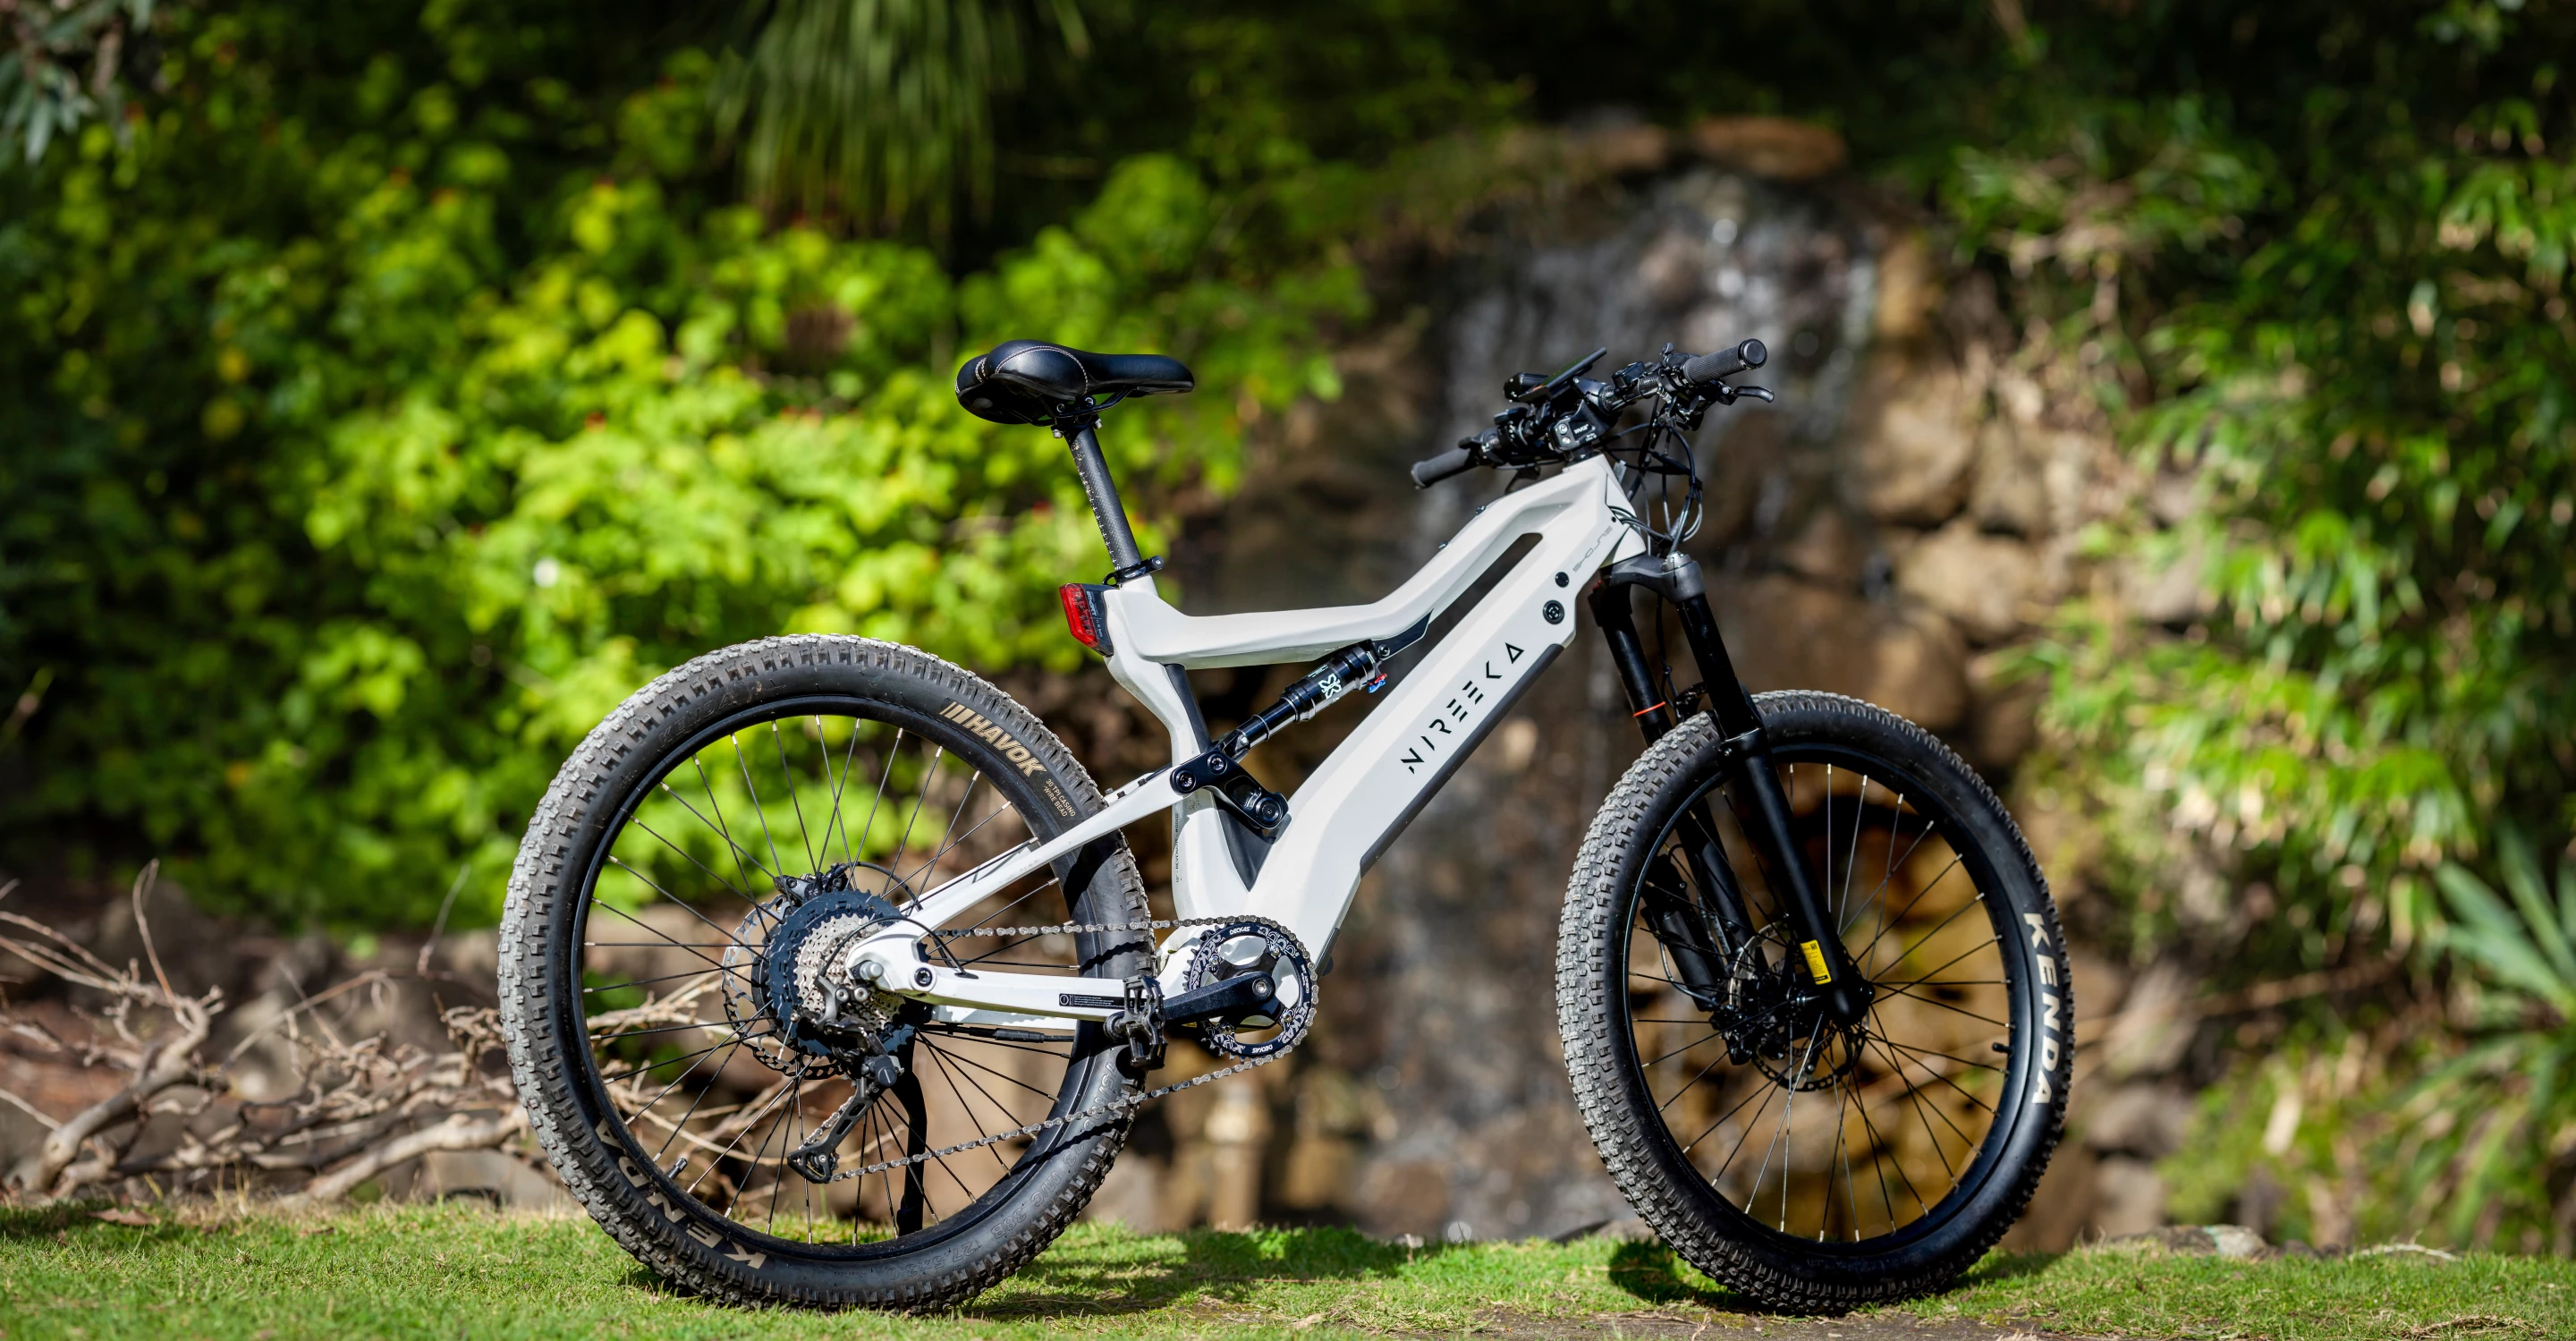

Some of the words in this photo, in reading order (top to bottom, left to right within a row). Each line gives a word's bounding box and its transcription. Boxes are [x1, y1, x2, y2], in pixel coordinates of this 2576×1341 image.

[1400, 642, 1524, 775] NIREEKA
[962, 715, 1047, 777] HAVOK
[1044, 785, 1056, 802] WIRE
[1055, 801, 1067, 816] BEAD
[1046, 778, 1054, 787] 30
[1052, 785, 1062, 796] TPI
[1058, 795, 1075, 816] CASING
[1229, 926, 1250, 936] DECKAS
[2023, 912, 2061, 1104] KENDA
[1251, 1043, 1274, 1054] DECKAS
[595, 1118, 767, 1269] KENDA
